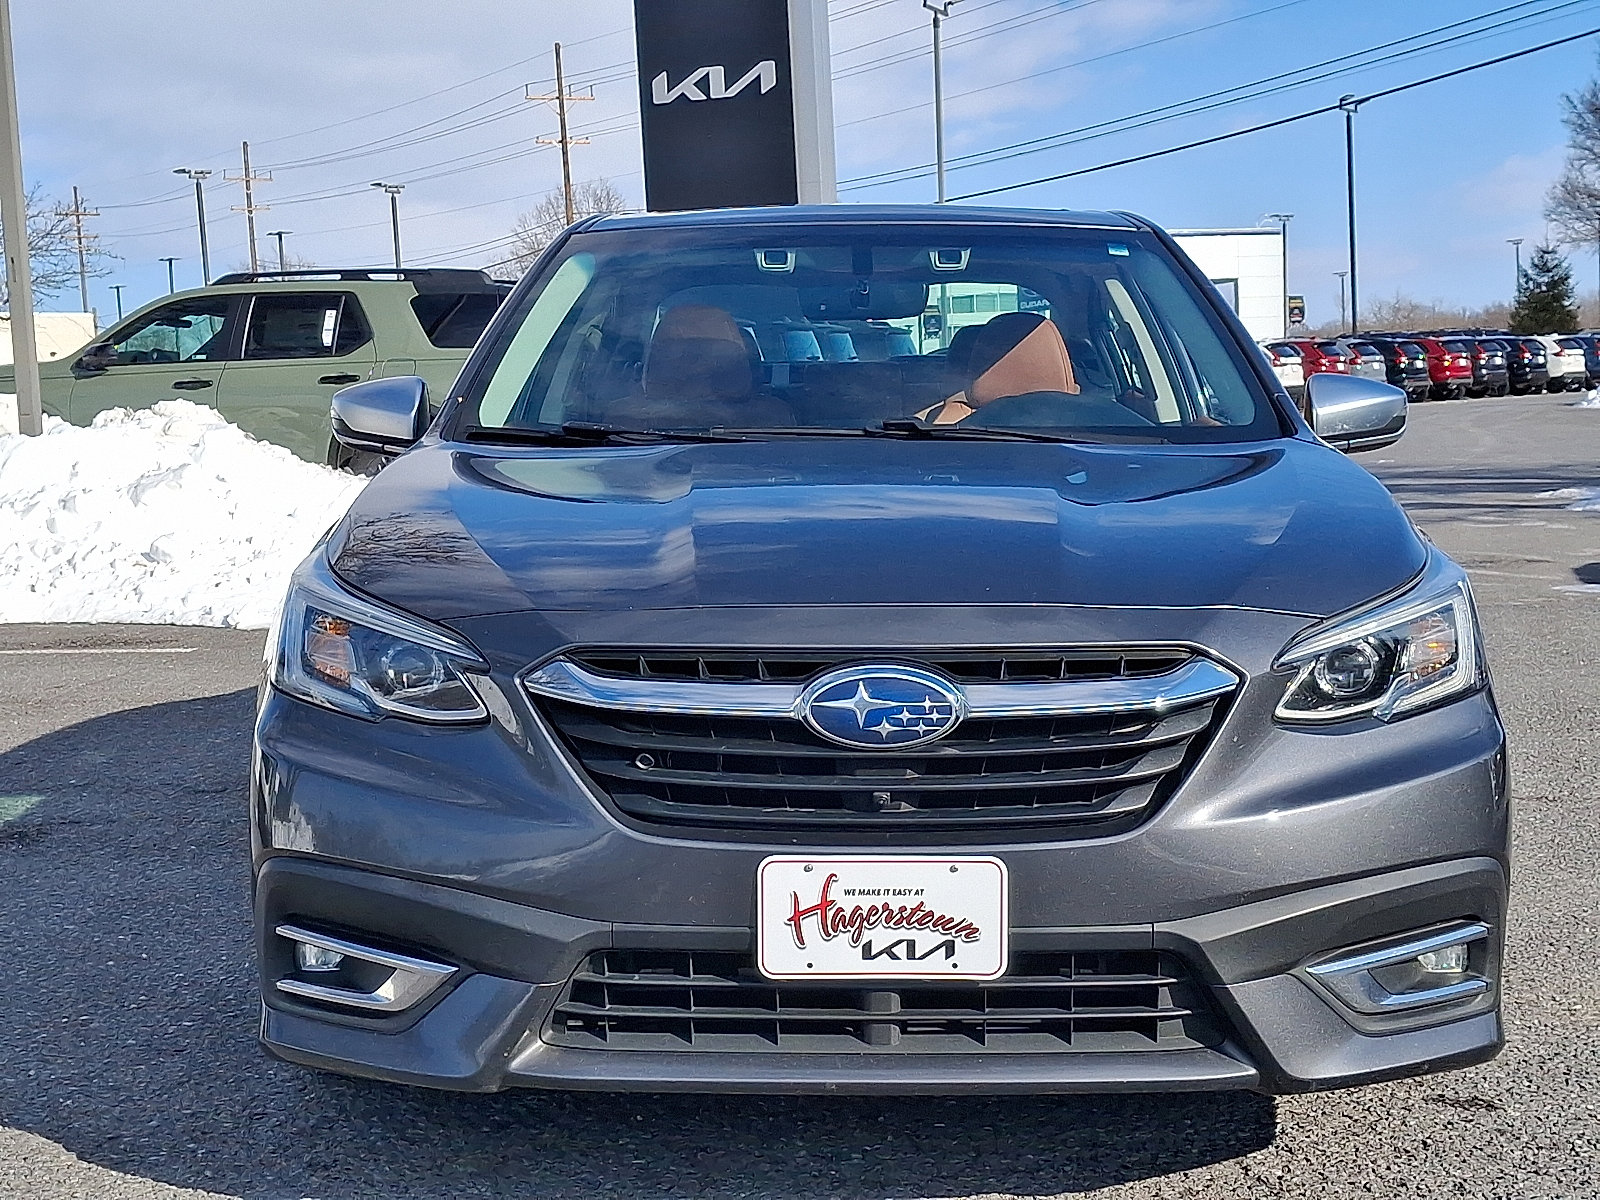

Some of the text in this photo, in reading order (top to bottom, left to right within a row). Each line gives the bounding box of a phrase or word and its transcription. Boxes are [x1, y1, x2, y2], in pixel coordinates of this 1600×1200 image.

[652, 60, 776, 104] KIA
[844, 888, 924, 897] WE MAKE IT EASY AT
[786, 873, 981, 948] Hagerstown
[862, 939, 955, 960] KIA
